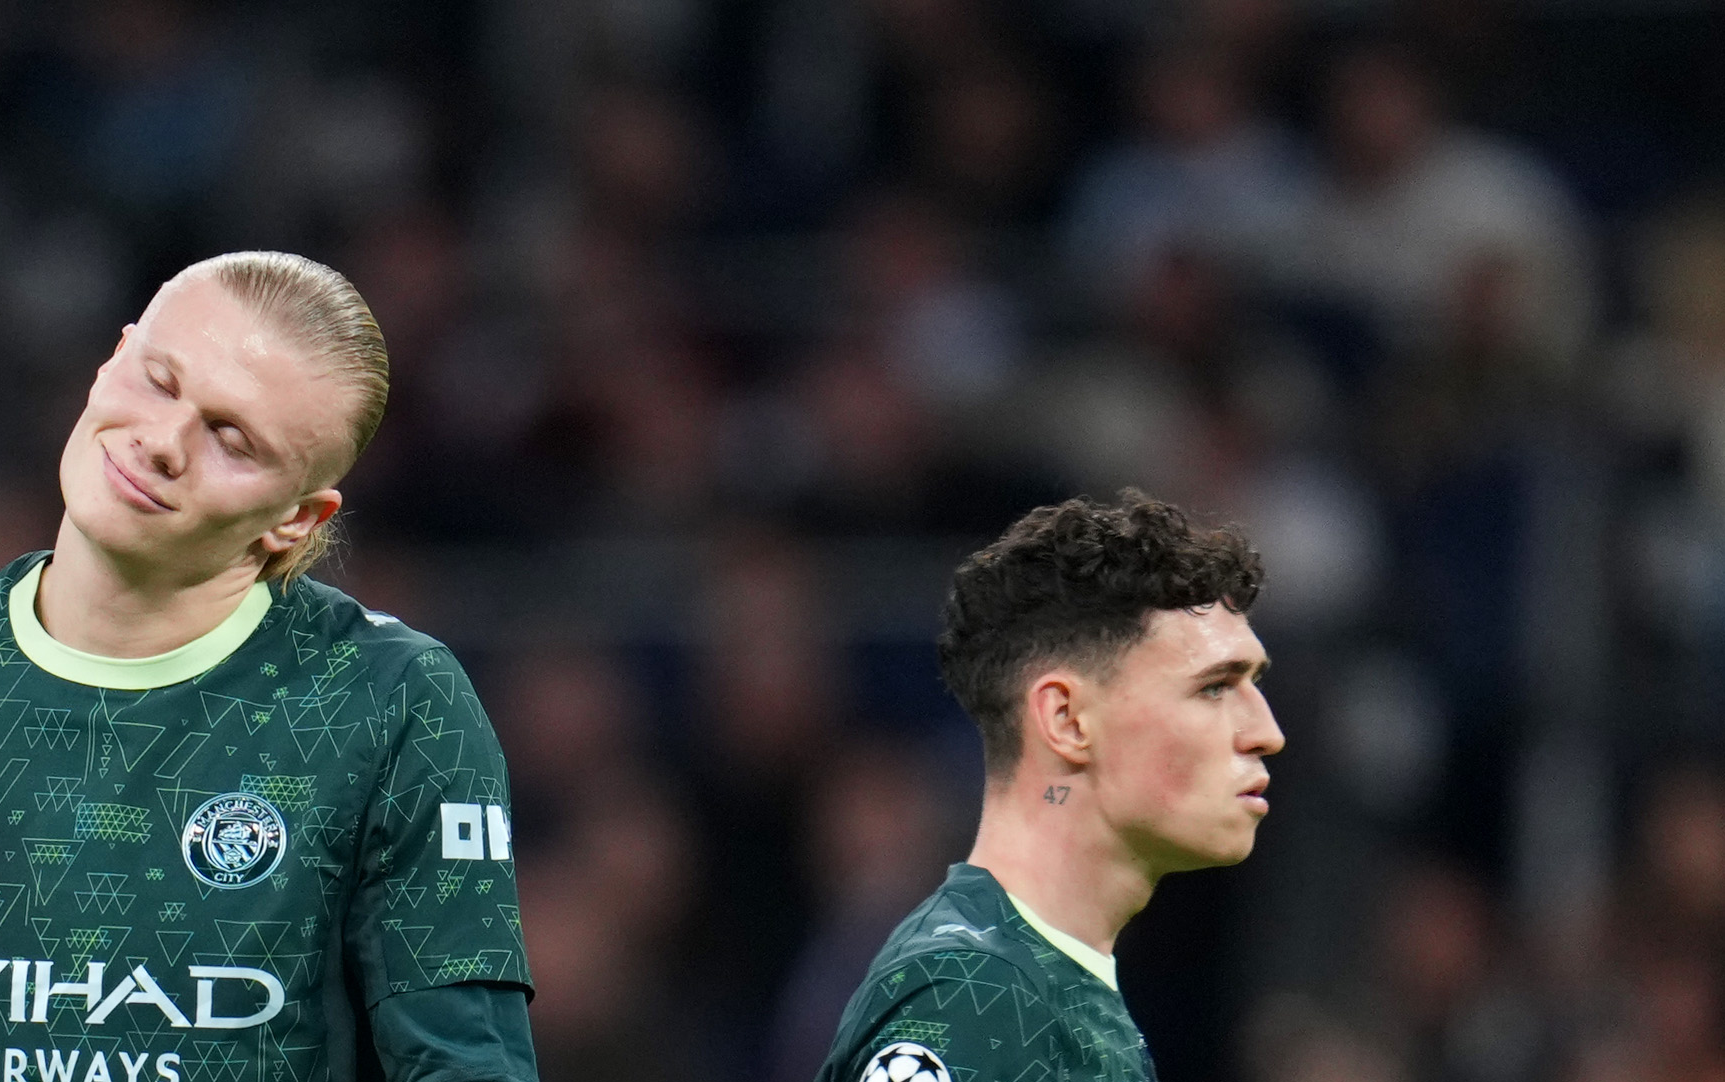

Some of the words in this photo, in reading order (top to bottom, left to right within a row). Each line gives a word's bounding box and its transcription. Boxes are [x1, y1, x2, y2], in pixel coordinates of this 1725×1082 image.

[1043, 785, 1071, 805] 47
[195, 800, 279, 833] MANCHESTER
[214, 872, 245, 884] CITY
